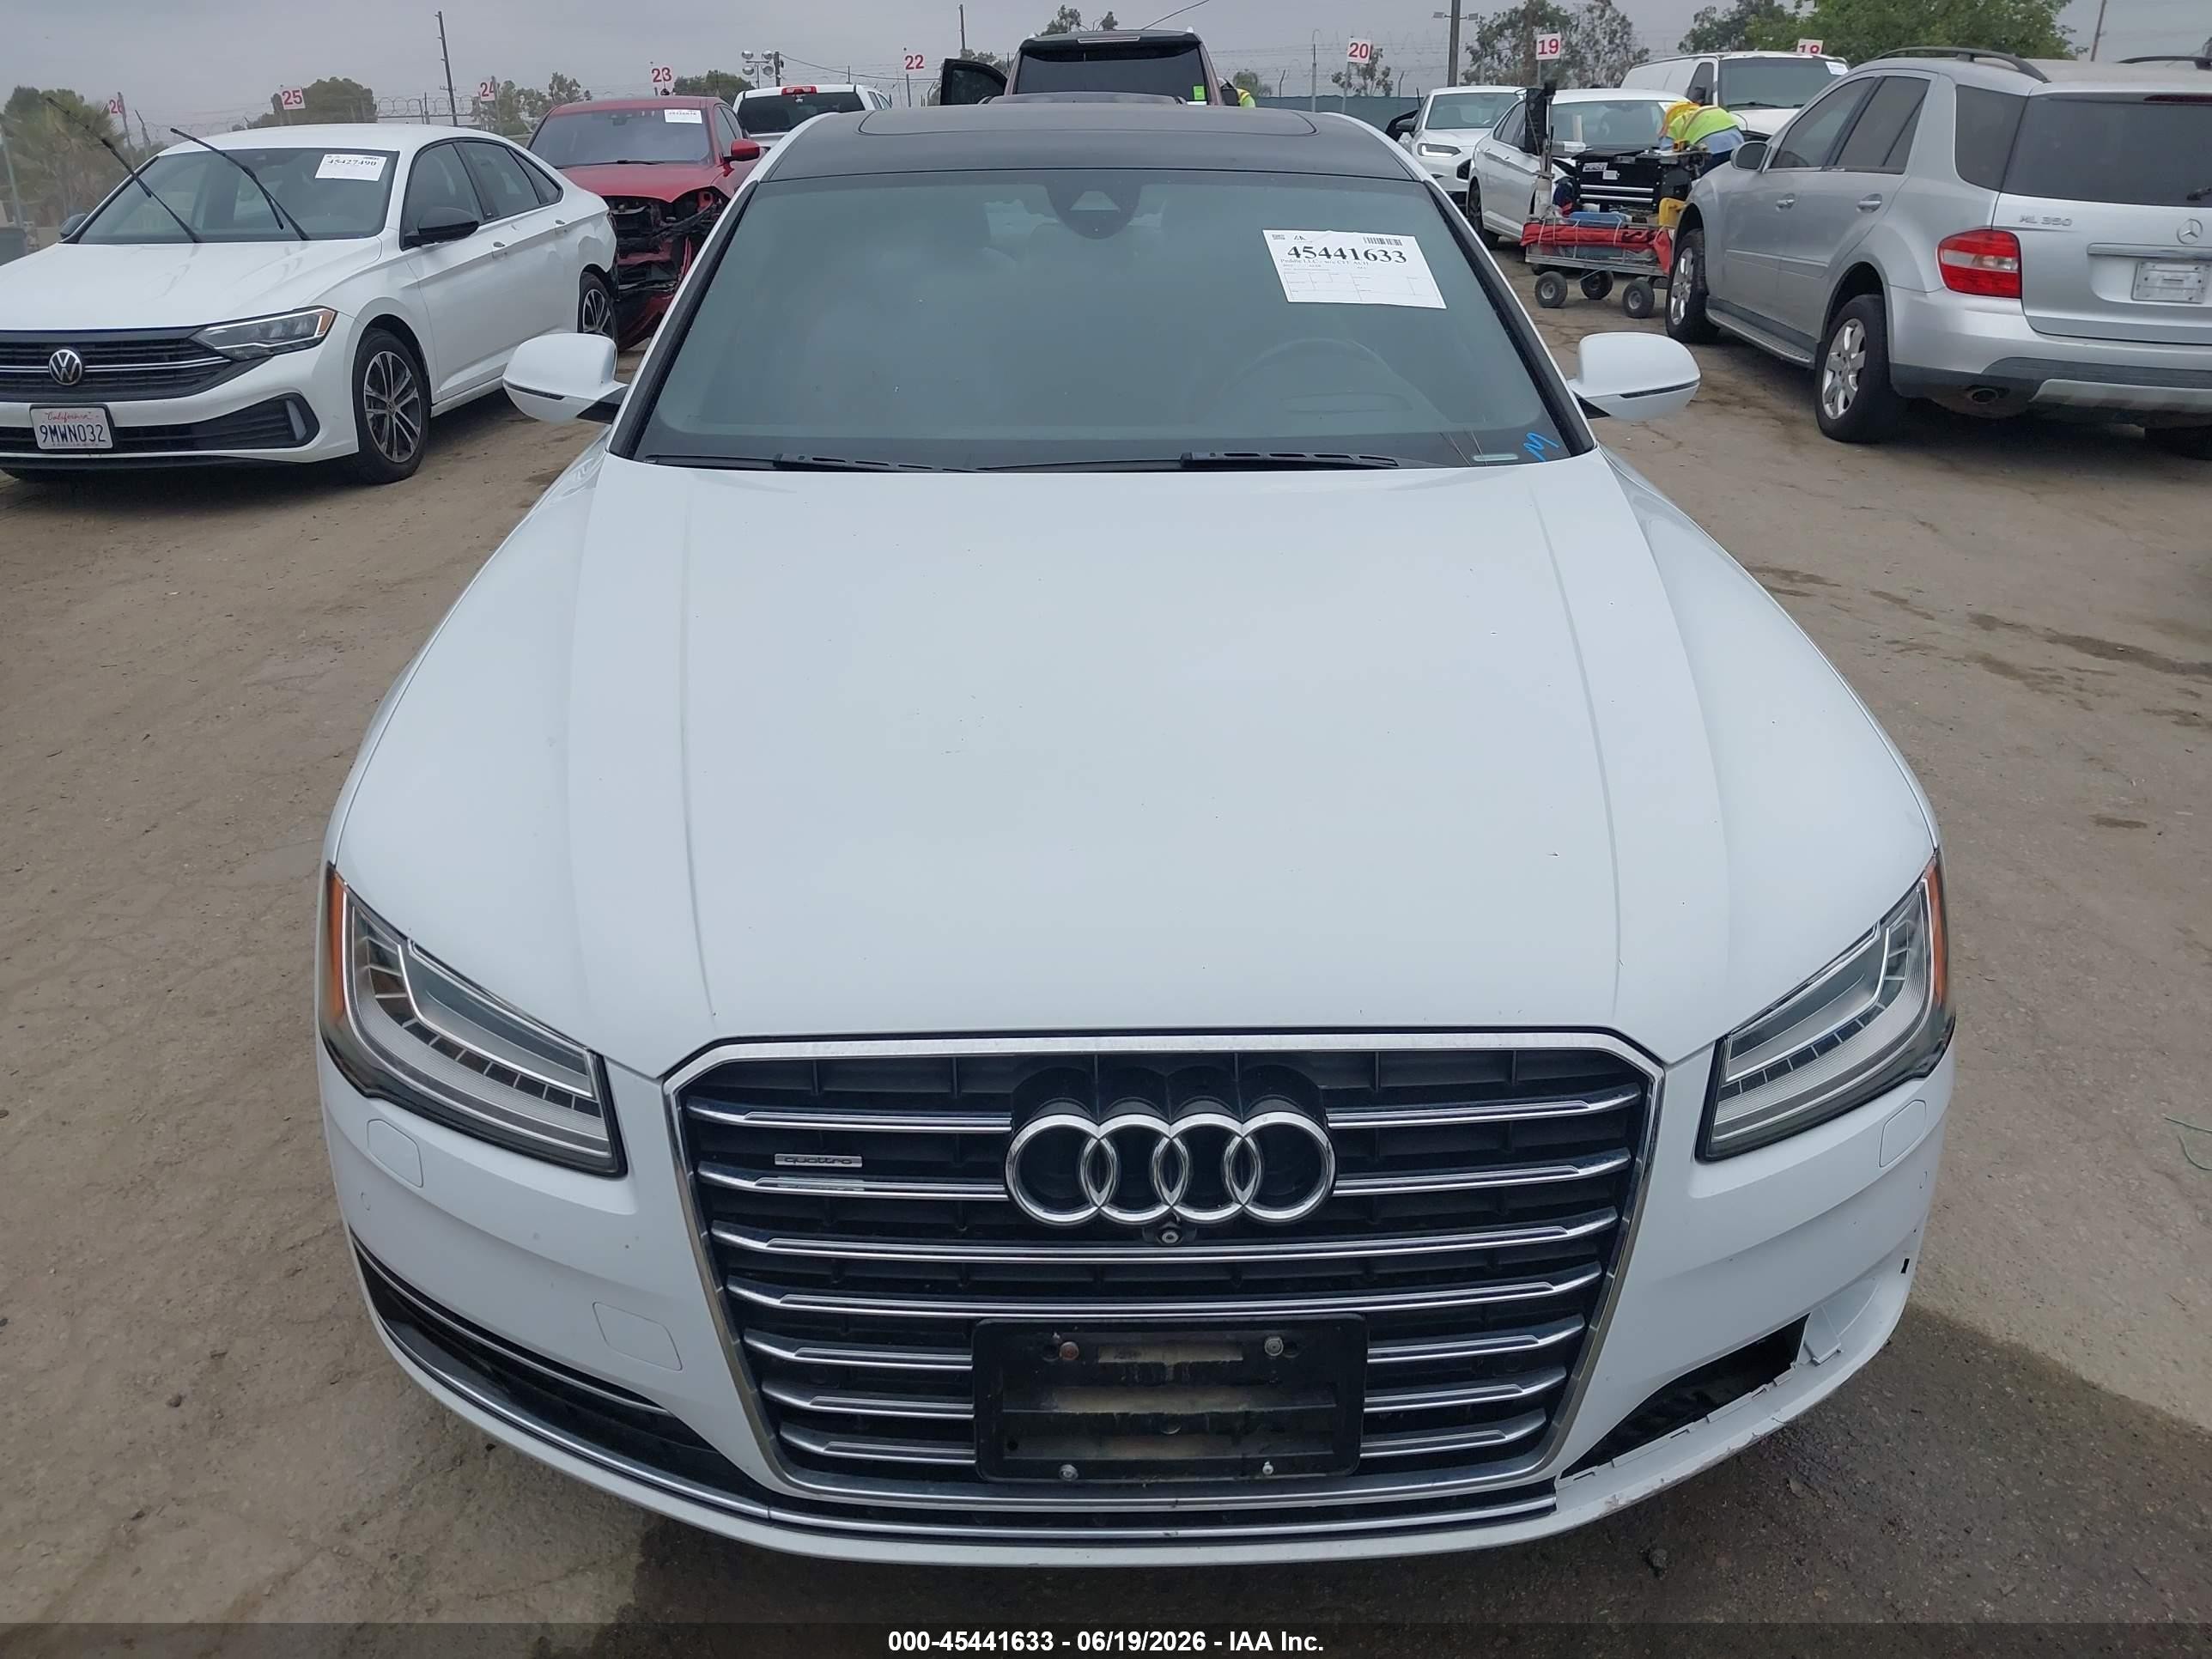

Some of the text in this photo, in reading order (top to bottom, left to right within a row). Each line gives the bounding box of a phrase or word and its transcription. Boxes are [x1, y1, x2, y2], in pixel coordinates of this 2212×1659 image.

[1348, 42, 1369, 59] 20
[1538, 38, 1559, 55] 19
[904, 54, 925, 70] 22
[651, 67, 672, 83] 23
[282, 89, 303, 106] 25
[2040, 216, 2073, 227] 350
[1287, 246, 1407, 264] 45441633
[39, 424, 106, 443] 9MWN032
